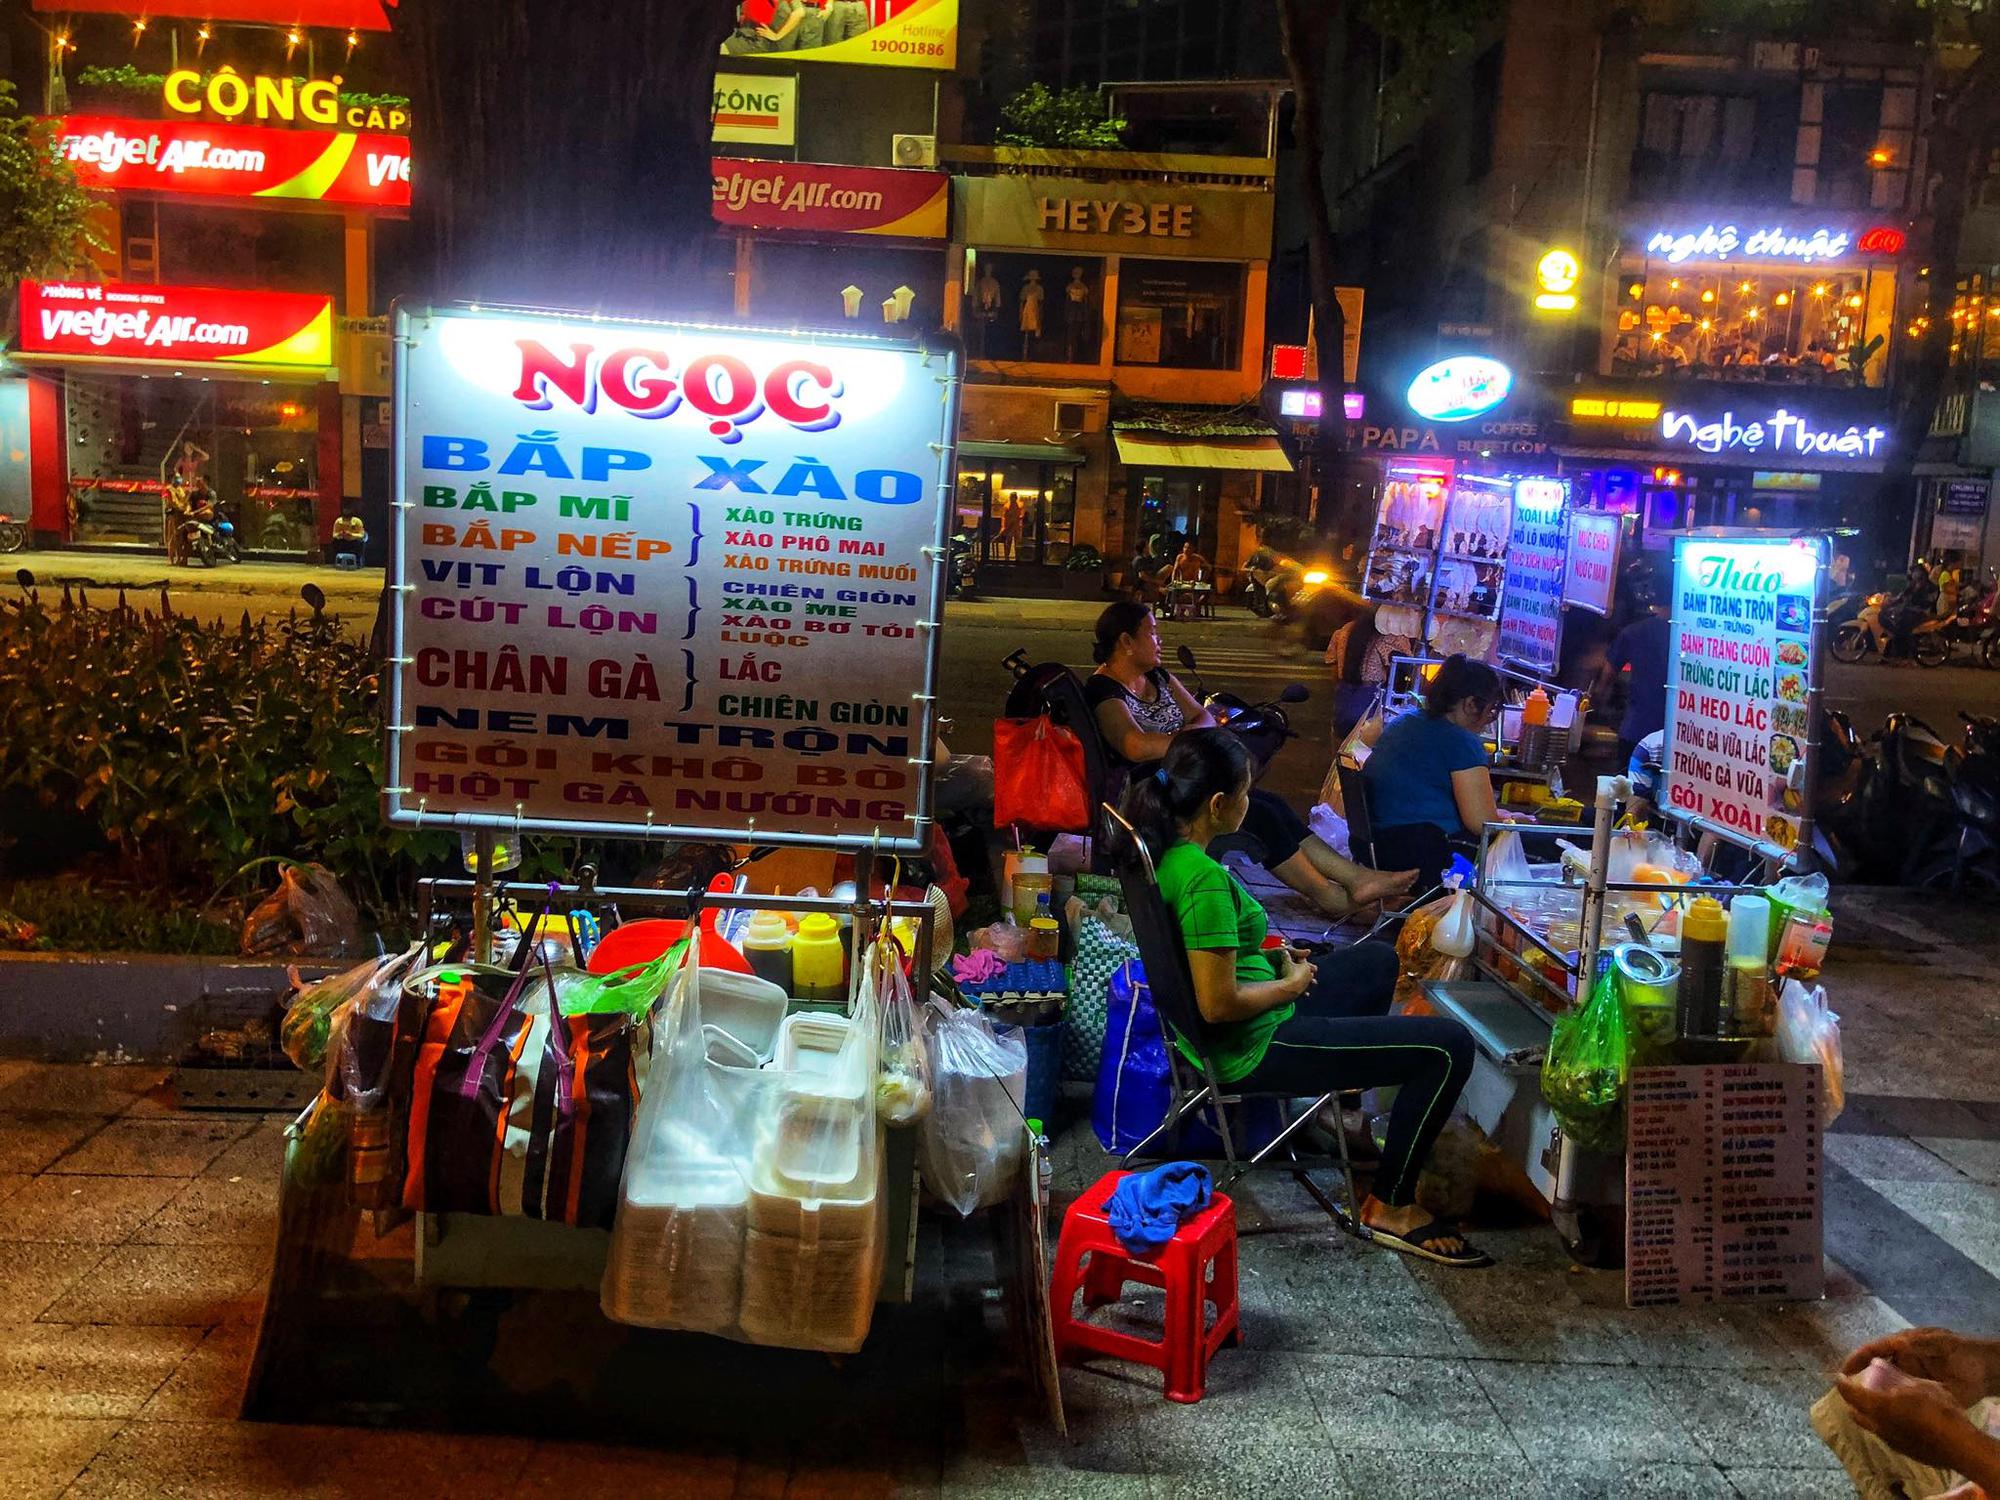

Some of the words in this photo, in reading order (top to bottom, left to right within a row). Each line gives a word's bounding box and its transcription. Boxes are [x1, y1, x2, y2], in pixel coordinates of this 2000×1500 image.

[871, 40, 945, 56] 19001886
[163, 64, 339, 122] CỘNG
[512, 338, 843, 442] NGỌC
[1362, 427, 1440, 451] PAPA
[1482, 423, 1537, 436] COFFEE
[422, 429, 653, 482] BẮP
[693, 455, 922, 505] XÀO
[423, 481, 537, 513] BẮP
[725, 506, 775, 524] XÀO
[783, 508, 863, 531] TRỨNG
[422, 518, 537, 551] BẮP
[557, 531, 673, 561] NẾP
[723, 530, 774, 548] XÀO
[782, 534, 830, 552] PHÔ
[838, 540, 886, 556] MAI
[420, 559, 505, 588] VỊT
[525, 565, 636, 595] LỘN
[723, 553, 769, 571] XÀO
[777, 555, 851, 577] TRỨNG
[858, 562, 918, 582] MUỐI
[721, 597, 793, 613] XÀO
[805, 602, 858, 618] ME
[723, 581, 824, 600] CHIÊN
[836, 588, 916, 606] GIÒN
[1710, 591, 1742, 617] TRÁNG
[1745, 594, 1774, 625] TRỘN
[420, 596, 528, 625] CÚT
[547, 604, 658, 635] LỘN
[720, 614, 792, 630] XÀO
[804, 620, 852, 634] BƠ
[719, 651, 783, 683] LẮC
[1707, 634, 1739, 662] TRÁNG
[1741, 637, 1770, 668] CUỐN
[416, 643, 568, 696] CHÂN
[588, 653, 661, 701] GÀ
[1680, 657, 1714, 688] TRỨNG
[1717, 665, 1741, 693] CÚT
[1744, 668, 1770, 700] LẮC
[718, 694, 818, 721] CHIÊN
[830, 698, 909, 727] GIÒN
[1678, 690, 1696, 713] DA
[1700, 695, 1731, 722] HEO
[1735, 698, 1767, 731] LẮC
[415, 705, 630, 740] NEM
[663, 721, 909, 756] TRỘN
[1676, 720, 1704, 748] TRỨNG
[1706, 727, 1719, 752] GÀ
[1745, 735, 1766, 767] LẮC
[591, 752, 764, 782] KHÔ
[796, 764, 906, 790] BÒ
[1674, 749, 1711, 782] TRỨNG
[1715, 762, 1731, 789] GÀ
[413, 771, 540, 801] HỘT
[563, 780, 651, 807] GÀ
[675, 788, 906, 822] NƯỚNG
[1671, 781, 1703, 813] GỎI
[1710, 798, 1762, 836] XOÀI
